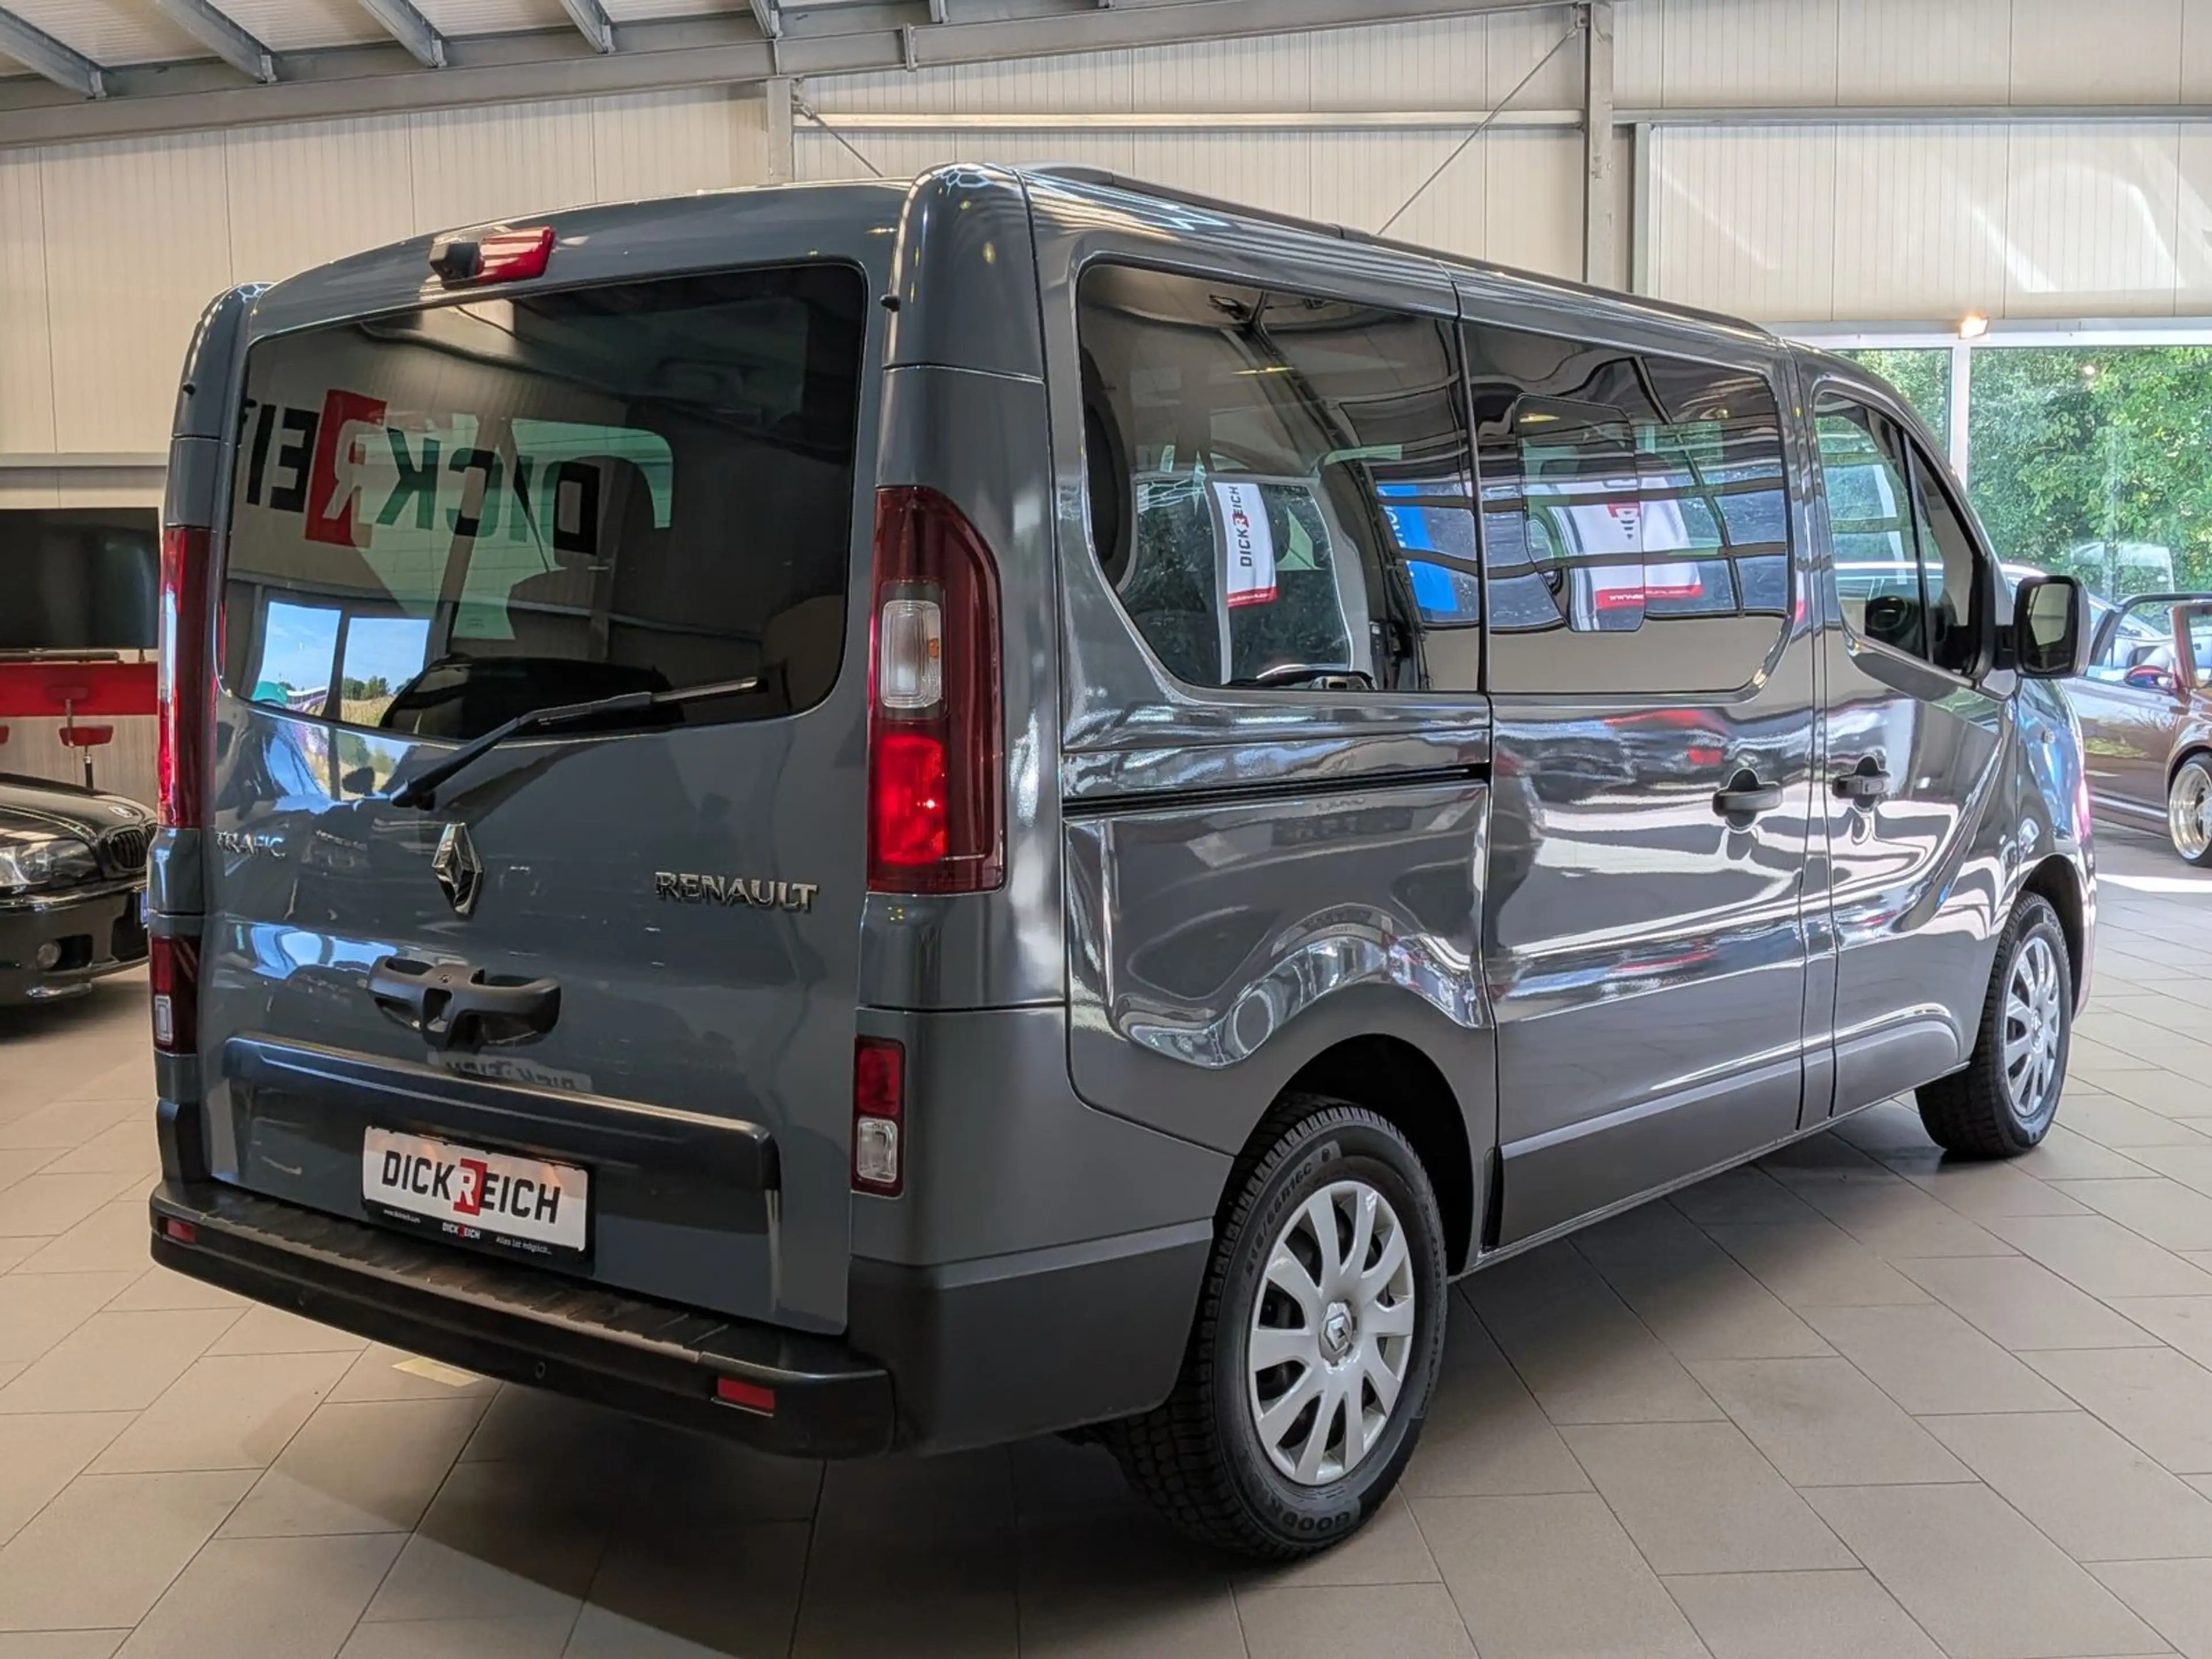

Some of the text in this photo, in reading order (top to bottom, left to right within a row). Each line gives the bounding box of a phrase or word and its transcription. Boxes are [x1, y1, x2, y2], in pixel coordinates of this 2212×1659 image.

[1228, 486, 1252, 567] DICKREICH
[654, 871, 818, 912] RENAULT
[382, 1150, 561, 1224] DICKREICH
[442, 1221, 481, 1239] DICKREICH
